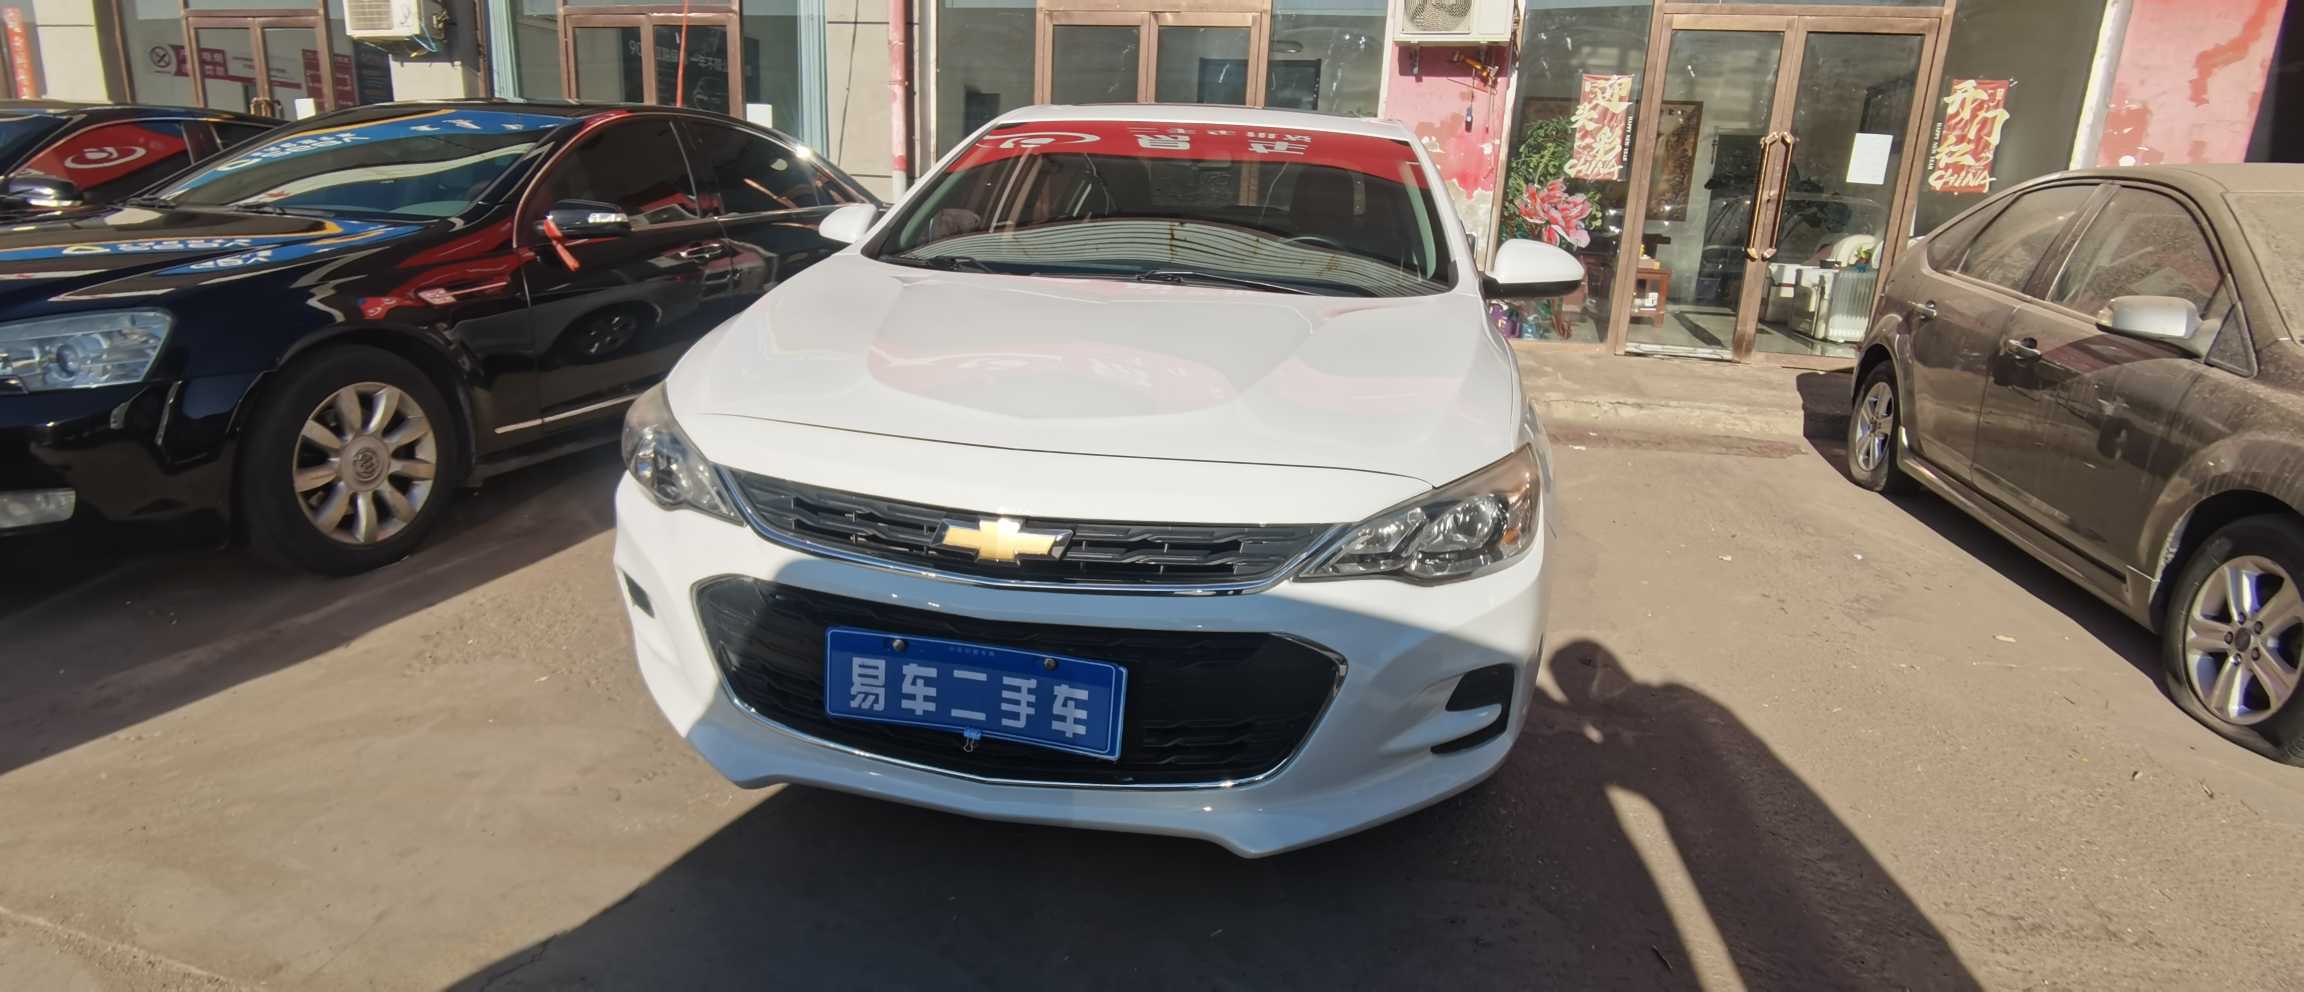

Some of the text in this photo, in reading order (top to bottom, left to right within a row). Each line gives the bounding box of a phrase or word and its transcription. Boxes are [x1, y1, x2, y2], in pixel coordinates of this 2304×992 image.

[1935, 79, 2010, 168] 开门红
[1928, 168, 1997, 193] CHINA
[850, 656, 1089, 738] 易车二手车
